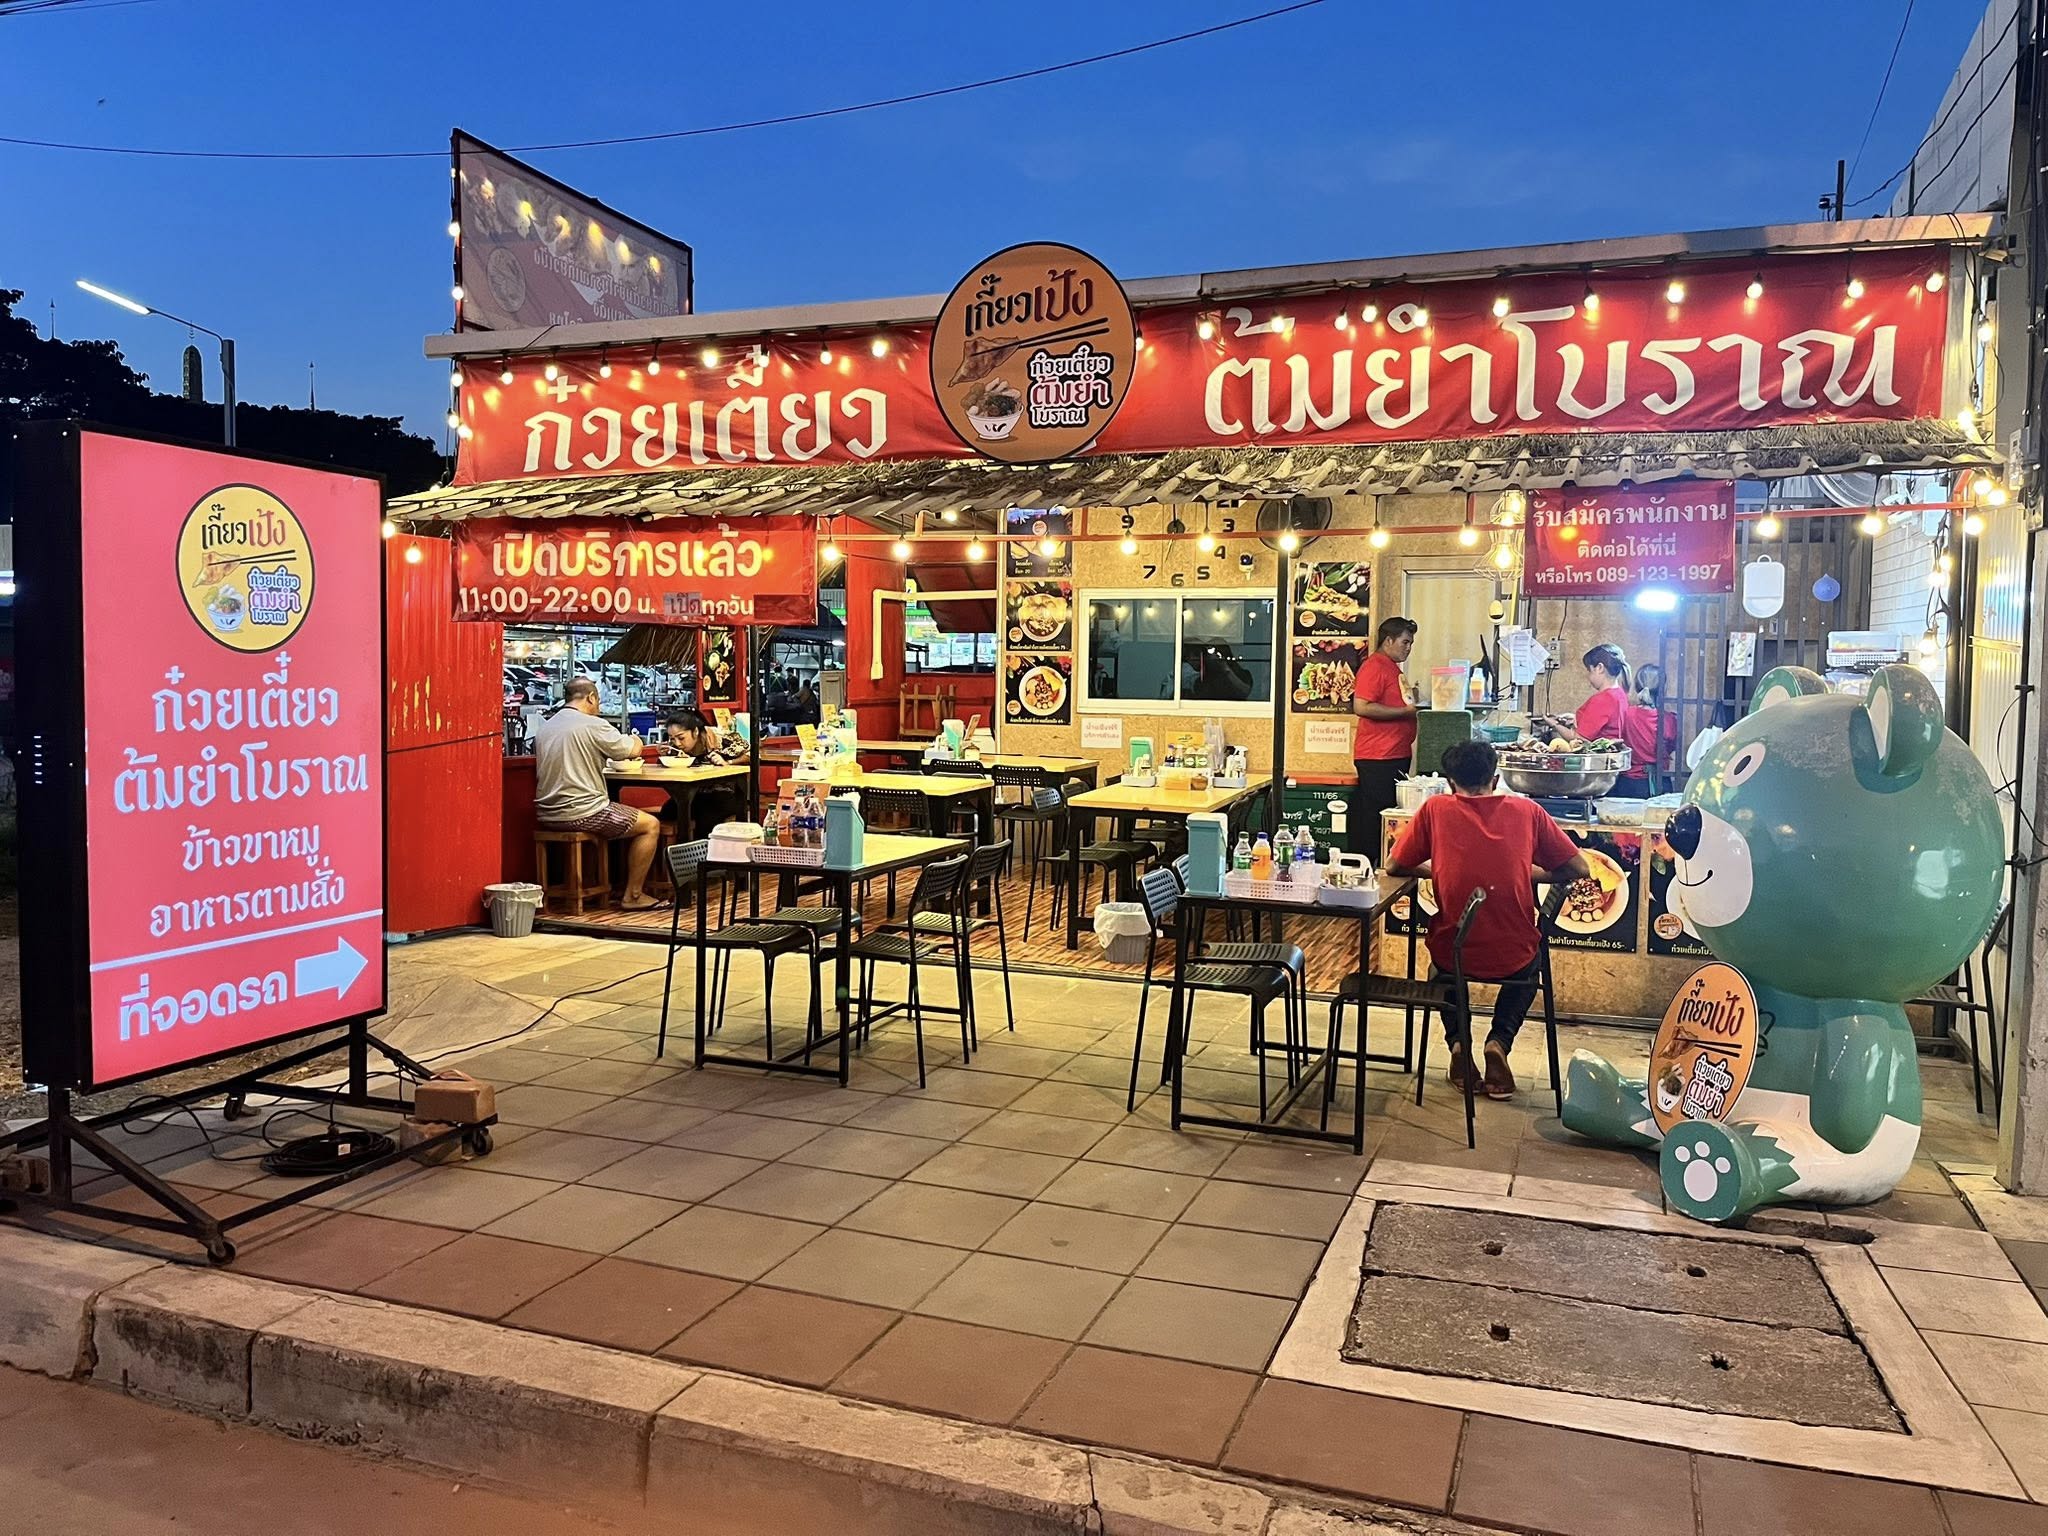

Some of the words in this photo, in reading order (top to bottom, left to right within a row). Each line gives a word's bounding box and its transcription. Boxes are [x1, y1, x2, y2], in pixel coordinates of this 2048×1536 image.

[965, 269, 1093, 337] เกี๊ยวเป้ง
[1031, 346, 1110, 377] ก๋วยเตี๋ยว
[1204, 303, 1902, 436] ต้มยำโบราณ
[1032, 373, 1109, 406] ต้มยำ
[523, 345, 888, 473] ก๋วยเตี๋ยว
[1032, 407, 1086, 425] โบราณ
[202, 504, 287, 549] เกี๊ยวเป้ง
[1121, 515, 1134, 529] 9
[1222, 518, 1235, 533] 3
[1532, 497, 1727, 528] รับสมัครพนักงาน
[493, 523, 763, 577] เปิดบริการแล้ว
[1214, 545, 1226, 560] 4
[1577, 532, 1677, 559] ติดต่อได้ที่นี่
[250, 567, 298, 588] ก๋วยเตี๋ยว
[1143, 565, 1157, 579] 7
[1171, 573, 1184, 587] 6
[1197, 565, 1210, 580] 5
[1535, 565, 1591, 584] หรือโทร
[1596, 565, 1722, 583] 089-123-1997
[251, 586, 299, 610] ต้มยำ
[459, 586, 632, 615] 11:00-22:00
[638, 599, 656, 614] น.
[252, 608, 285, 622] โบราณ
[151, 651, 339, 733] ก๋วยเตี๋ยว
[113, 741, 369, 813] ต้มยำโบราณ
[182, 825, 320, 871] ข้าวขาหมู
[150, 856, 345, 937] อาหารตามสั่ง
[120, 973, 288, 1040] ที่จอดรถ
[1695, 1054, 1731, 1091] ก๋วยเตี๋ยว
[1688, 1074, 1725, 1116] ต้มยำ
